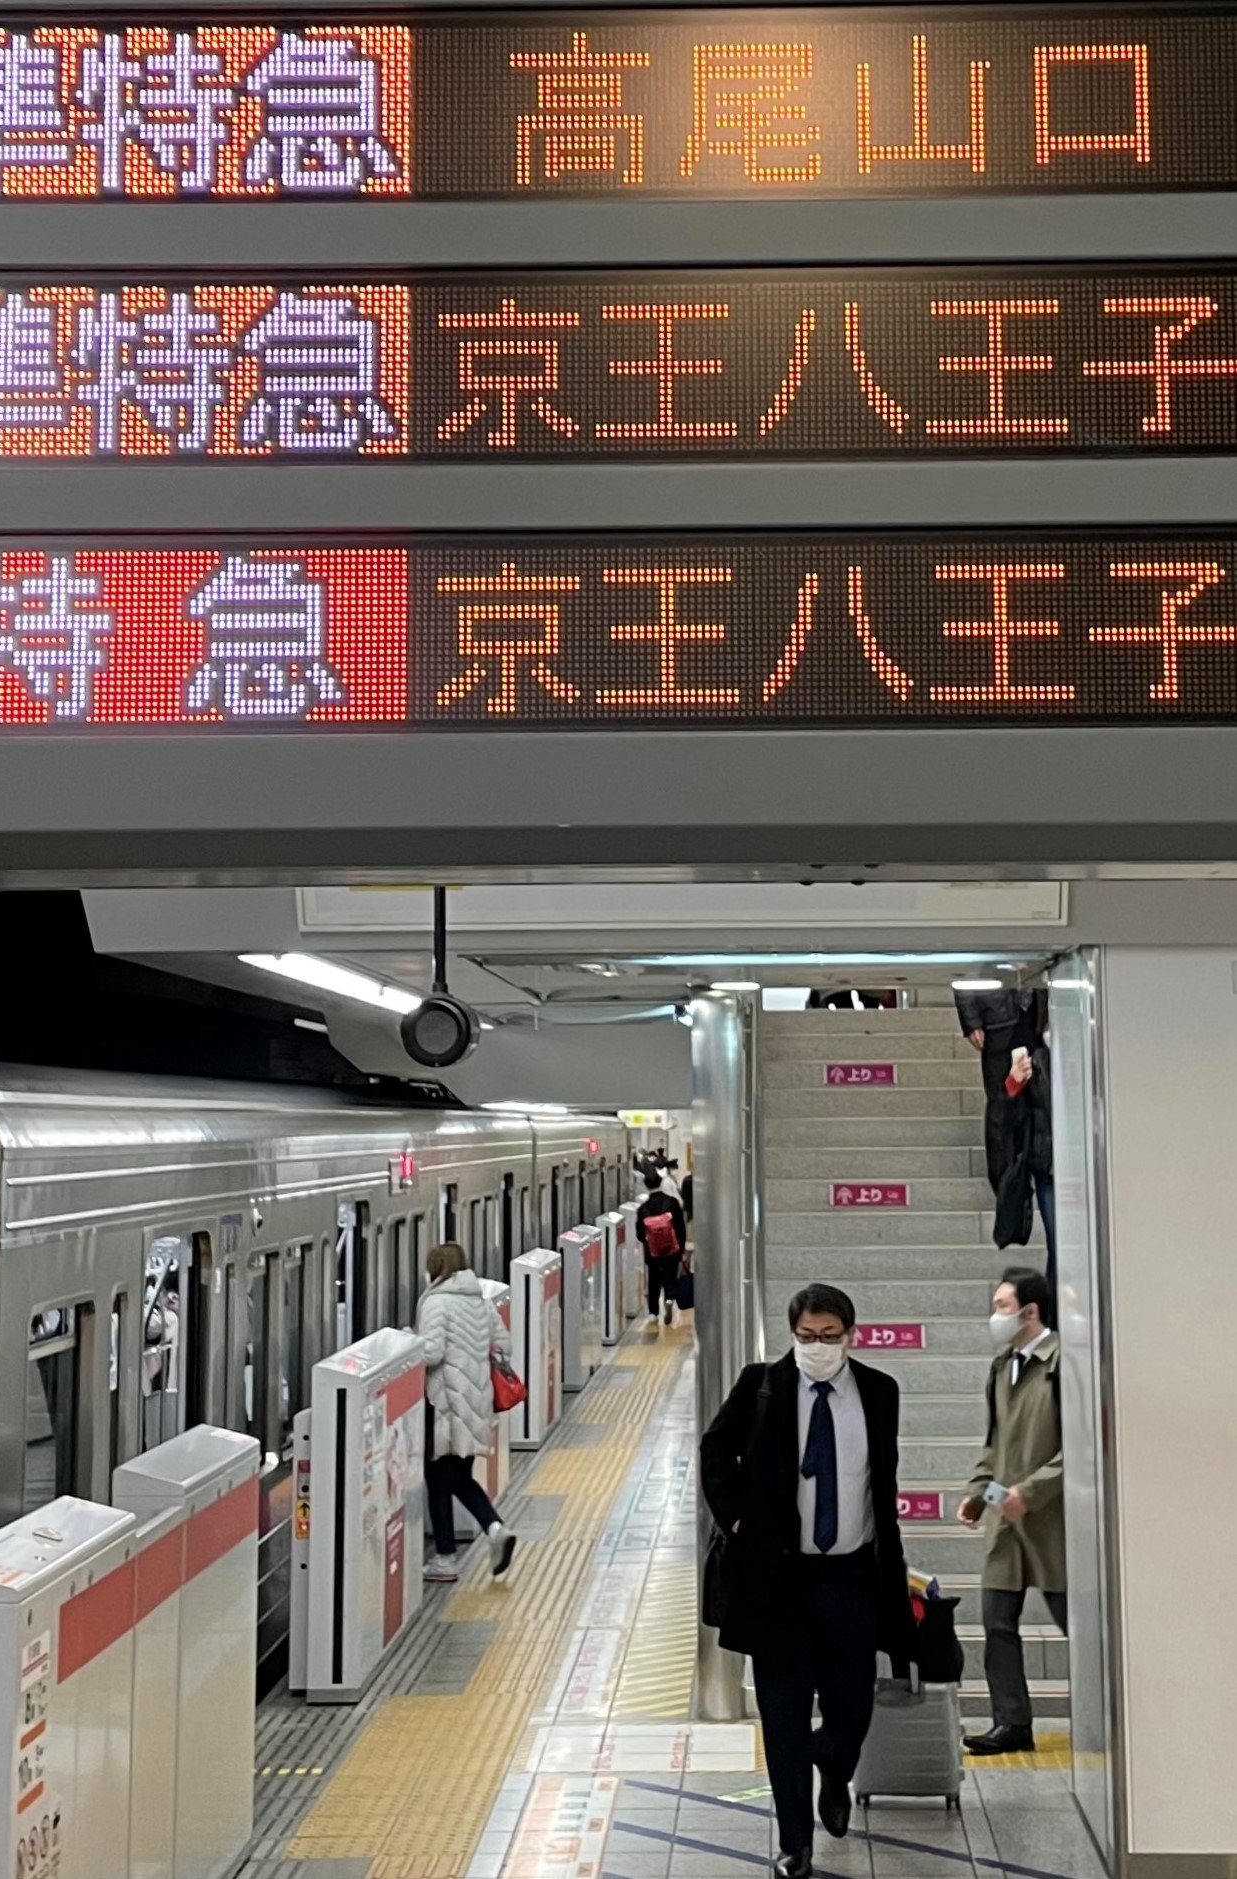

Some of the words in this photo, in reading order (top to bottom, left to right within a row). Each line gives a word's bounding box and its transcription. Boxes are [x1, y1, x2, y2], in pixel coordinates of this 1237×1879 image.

[509, 32, 1151, 185] 高尾山口
[438, 297, 1237, 447] 京王八王子
[437, 562, 1237, 712] 京王八王子
[847, 1067, 872, 1082] 上り
[856, 1187, 883, 1203] 上り
[867, 1328, 896, 1345] 上り
